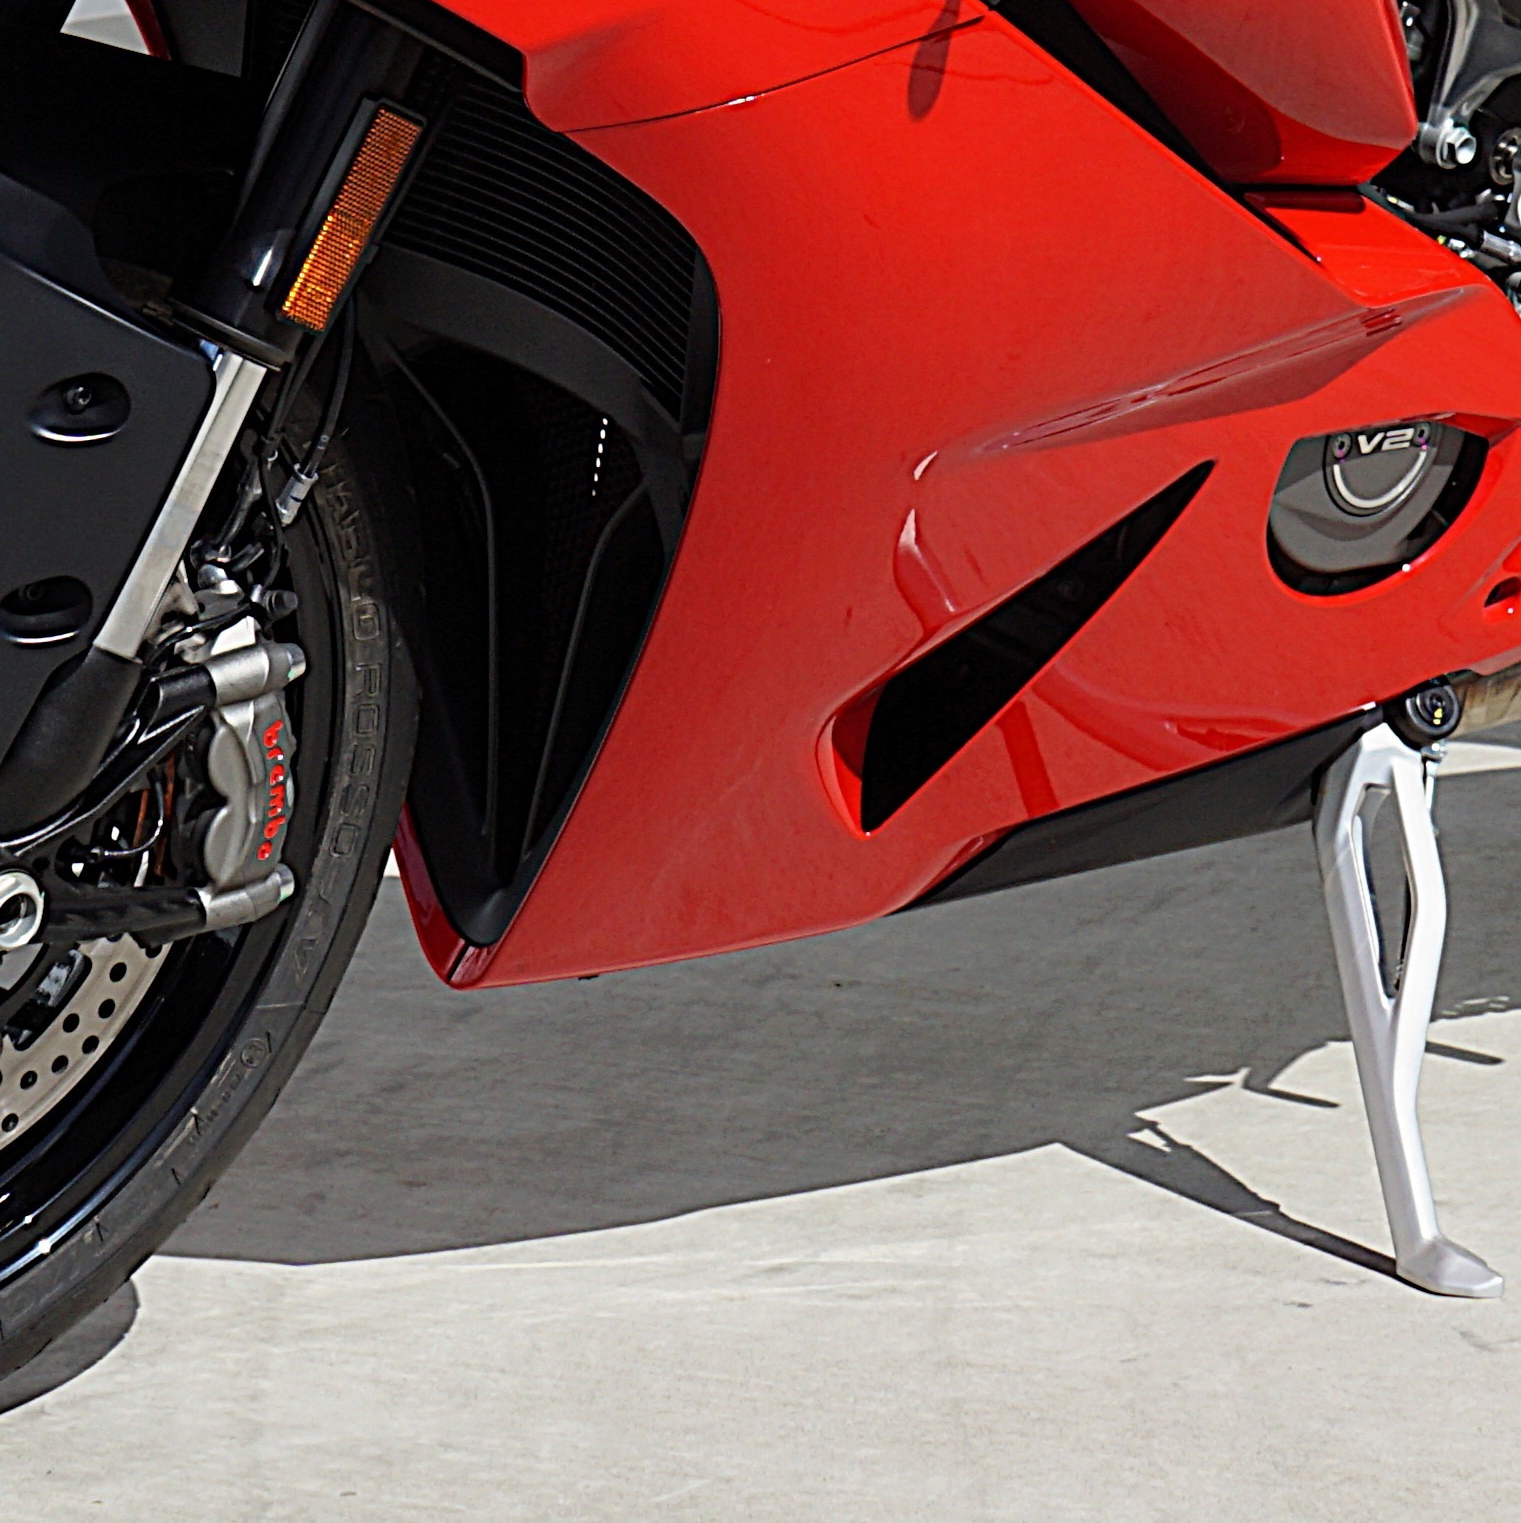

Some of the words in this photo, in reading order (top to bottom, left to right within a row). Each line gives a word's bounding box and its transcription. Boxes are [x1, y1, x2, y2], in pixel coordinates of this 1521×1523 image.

[1357, 427, 1415, 454] V2
[318, 461, 381, 641] IABLO
[257, 719, 286, 861] brembo
[329, 662, 382, 858] ROSSO
